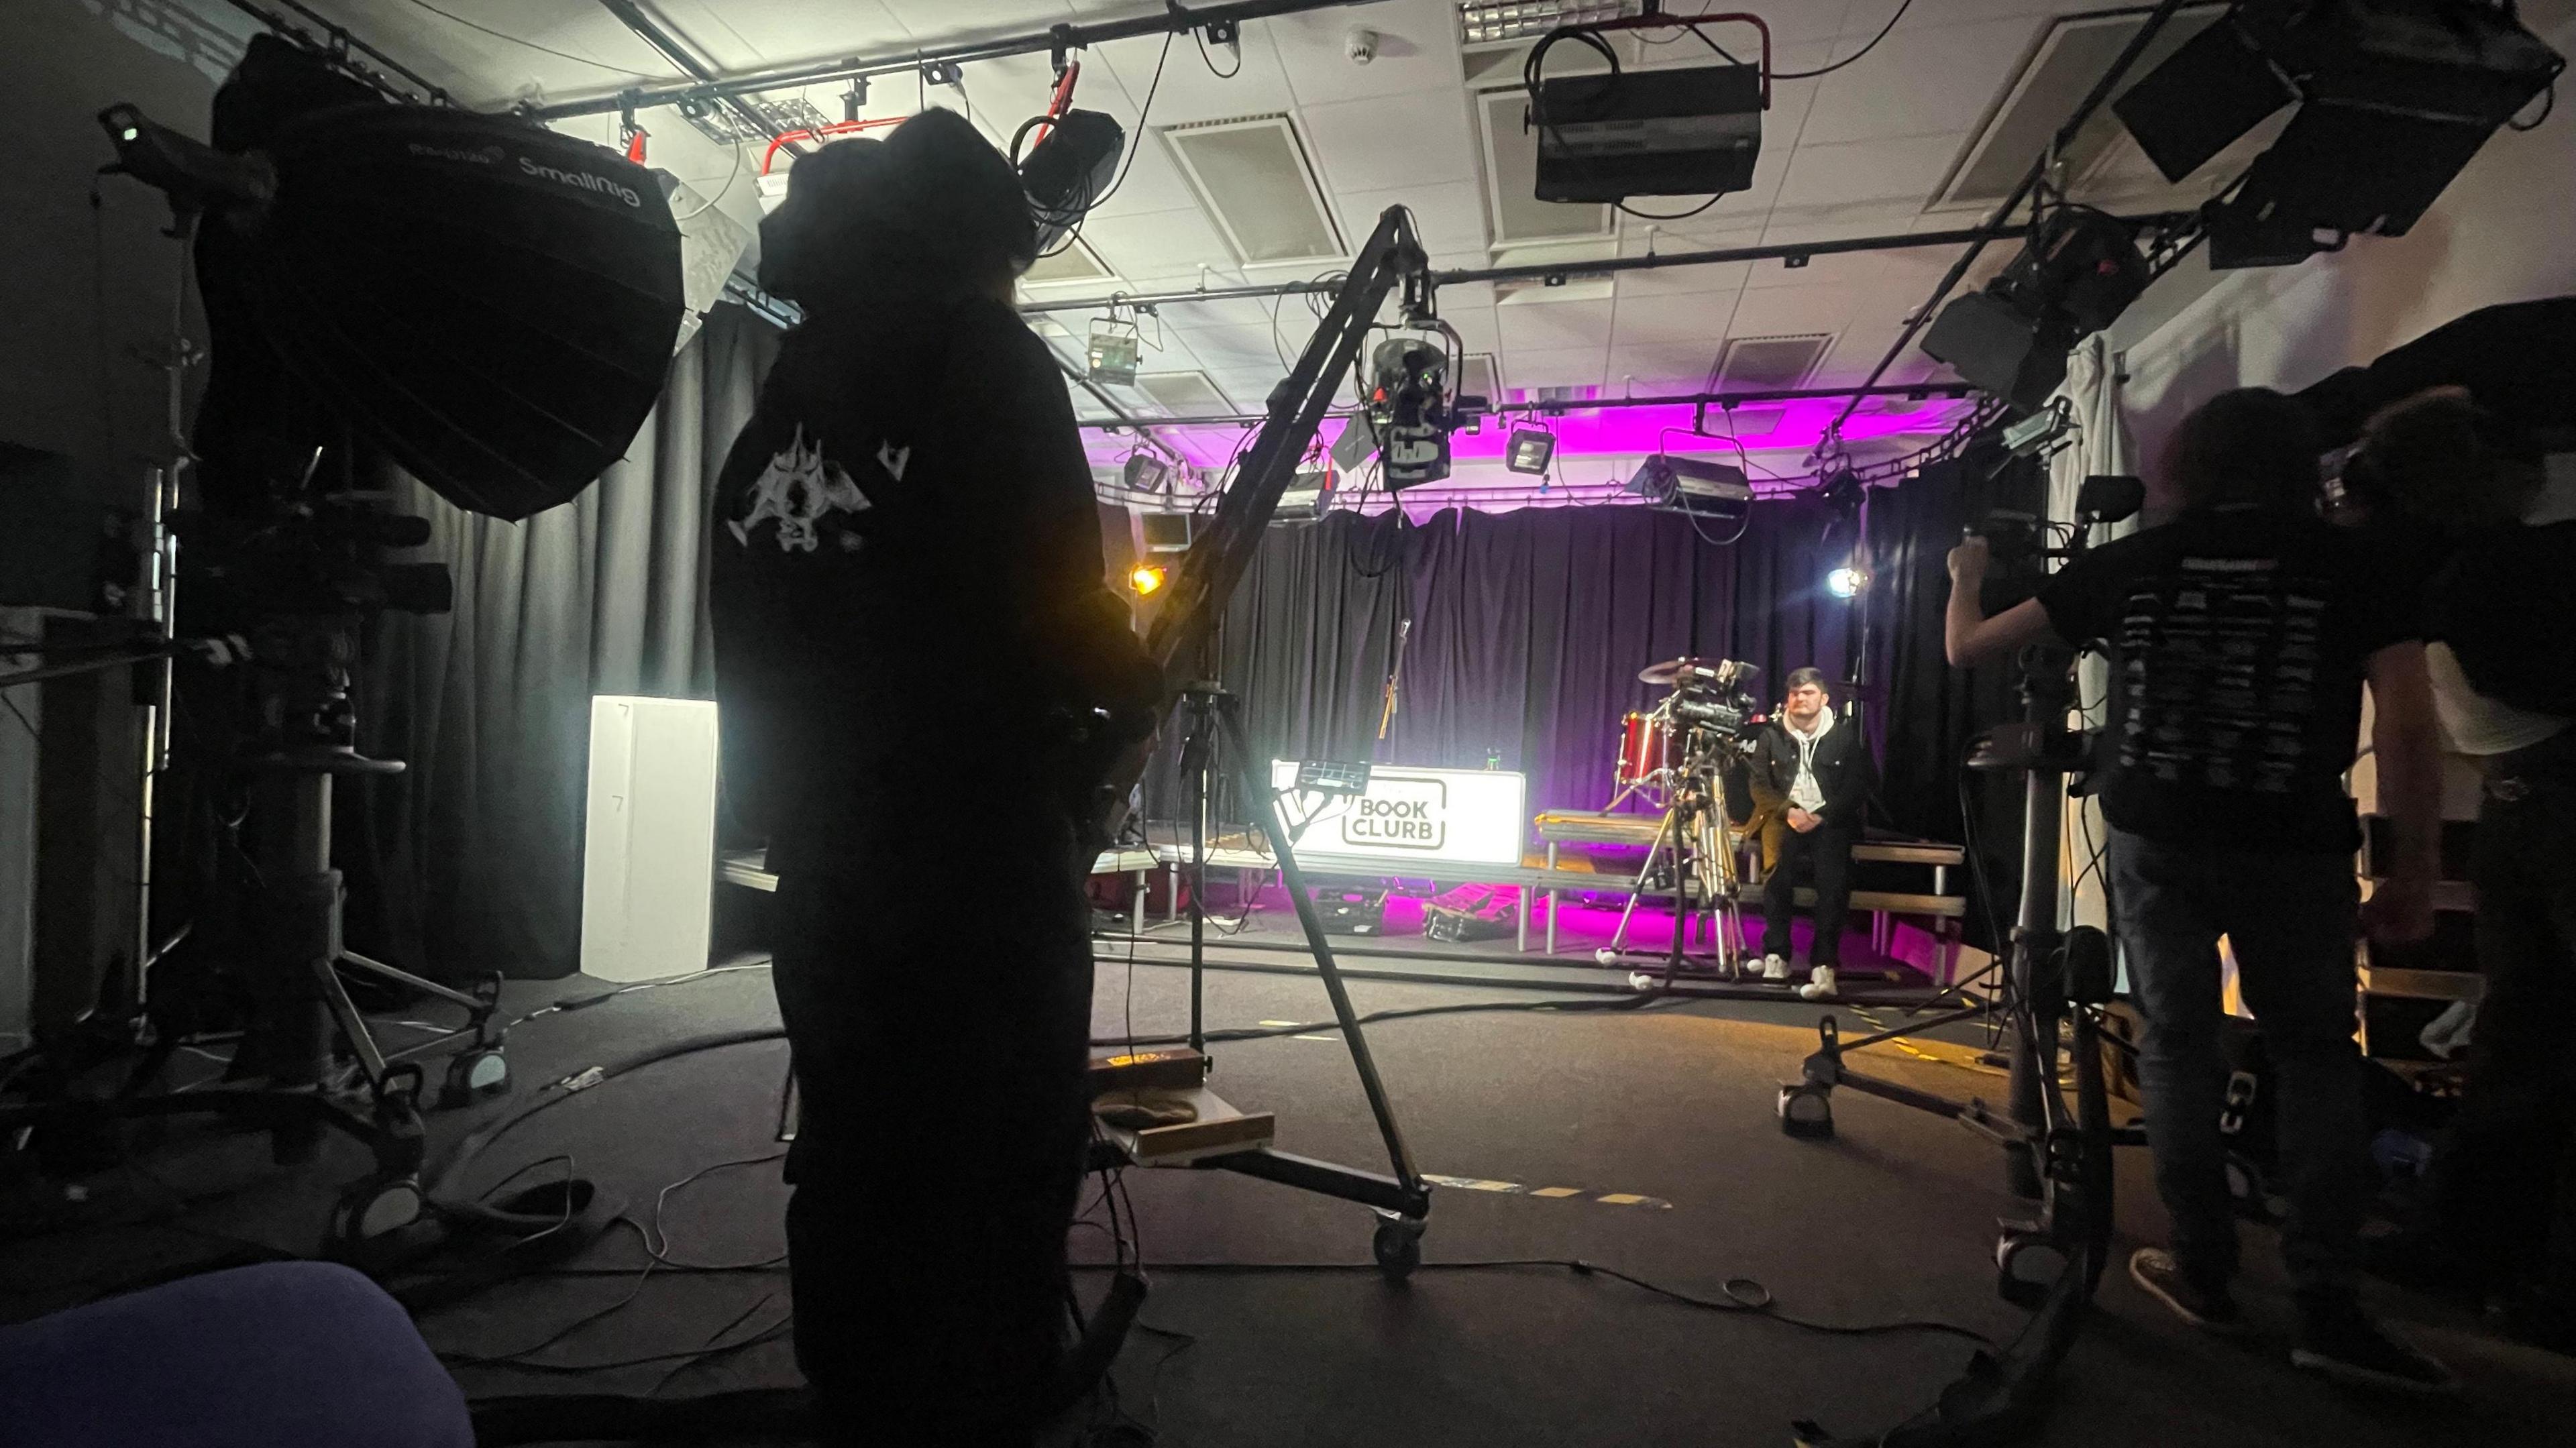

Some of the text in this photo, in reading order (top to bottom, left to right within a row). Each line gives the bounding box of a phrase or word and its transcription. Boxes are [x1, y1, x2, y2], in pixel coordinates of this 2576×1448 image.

[519, 157, 641, 207] SmallRig
[1361, 799, 1428, 819] BOOK
[1352, 819, 1432, 840] CLURB
